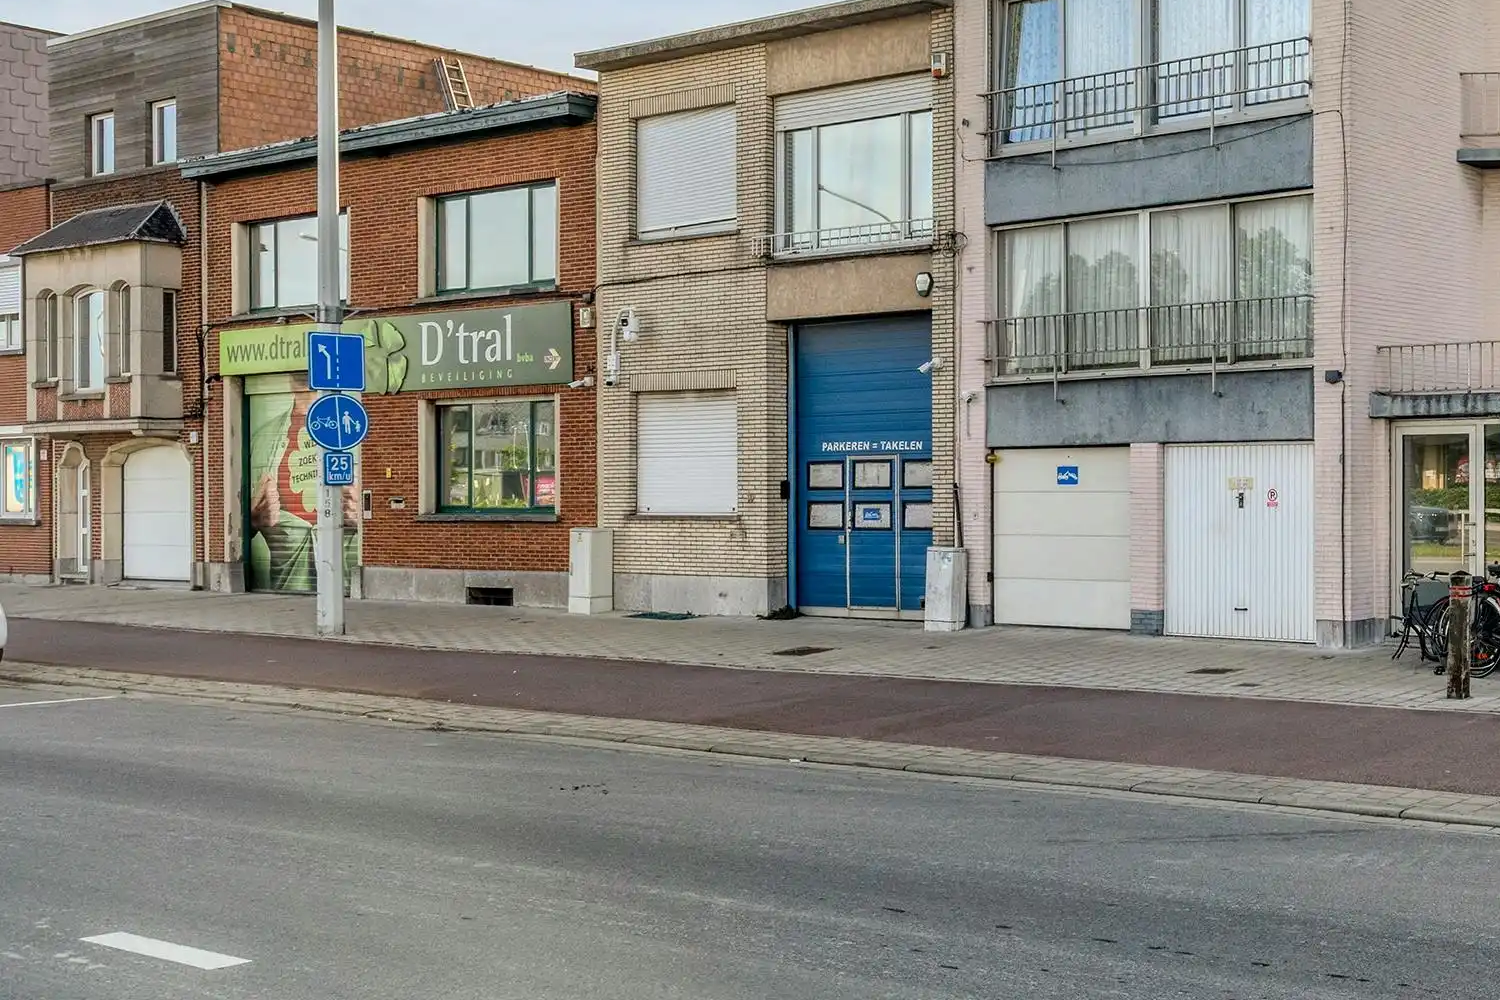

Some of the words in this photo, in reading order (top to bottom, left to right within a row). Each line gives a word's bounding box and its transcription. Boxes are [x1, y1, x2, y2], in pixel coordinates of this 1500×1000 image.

[418, 314, 512, 366] D'tral
[421, 369, 514, 384] BEVEILIGING
[822, 441, 870, 452] PARKEREN
[880, 440, 923, 451] TAKELEN
[331, 457, 348, 471] 25
[328, 471, 351, 481] km/u
